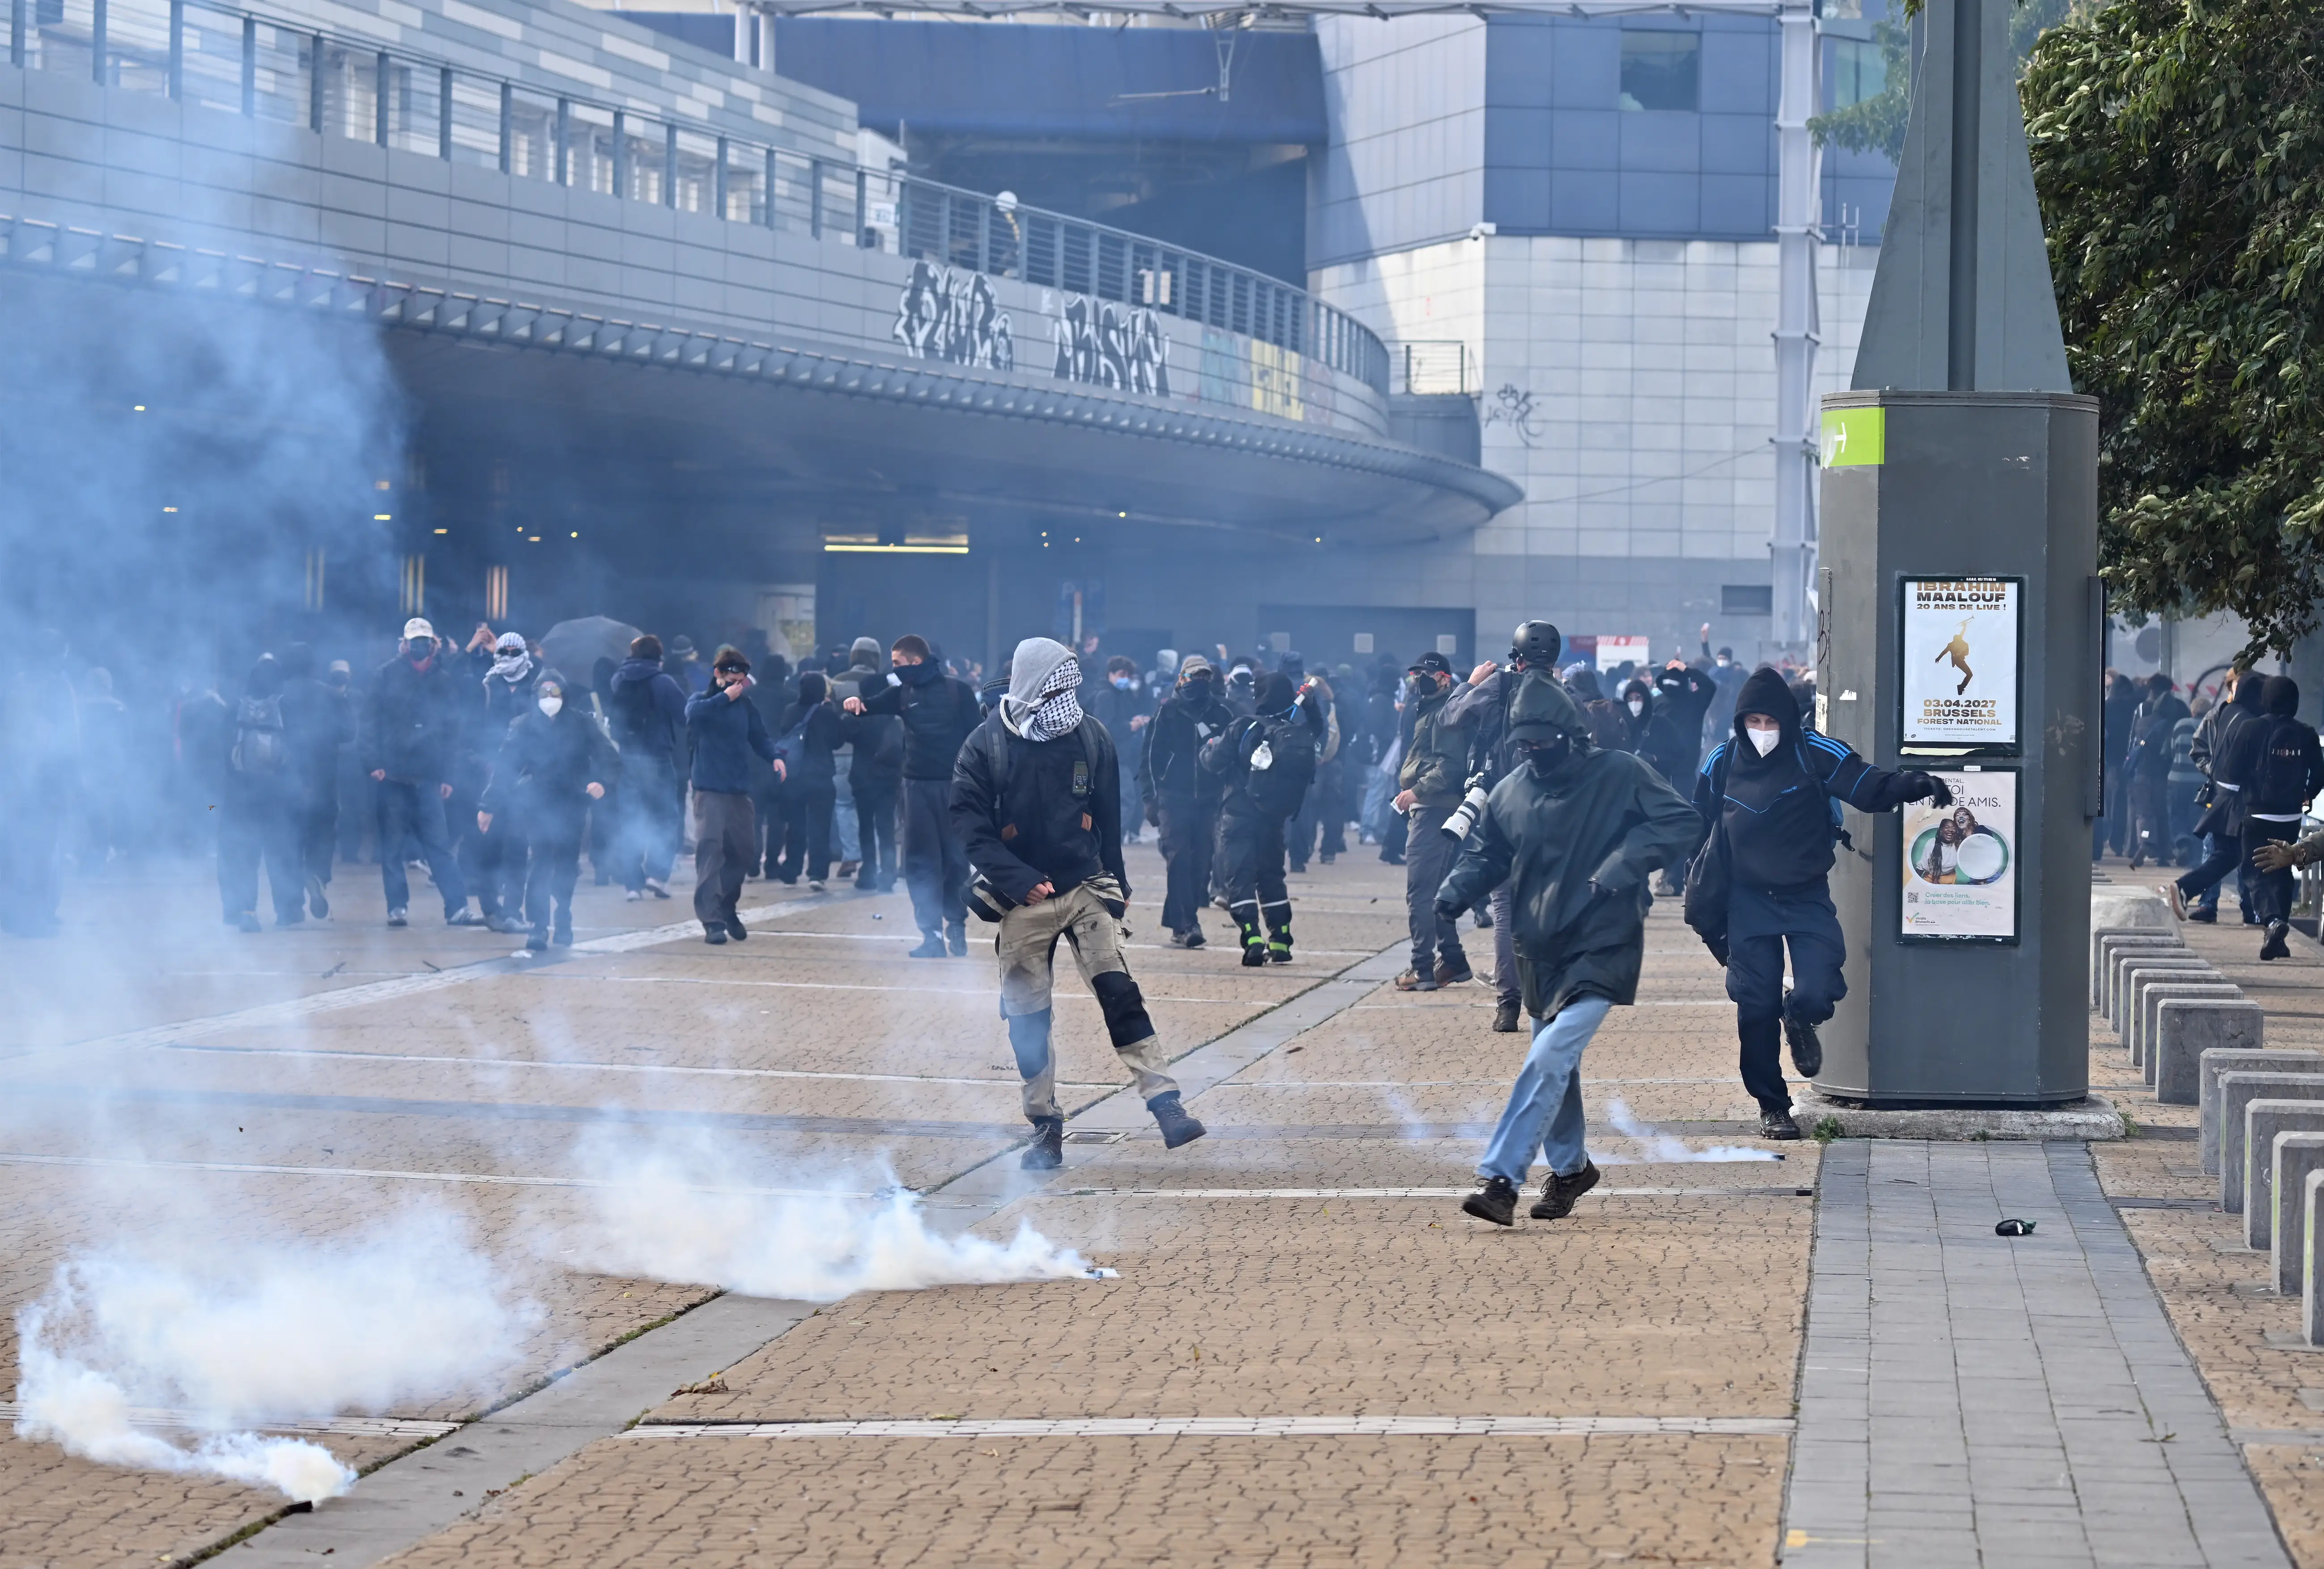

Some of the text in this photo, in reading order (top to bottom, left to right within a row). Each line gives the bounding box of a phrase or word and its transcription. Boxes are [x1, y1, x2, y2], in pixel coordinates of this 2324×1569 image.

[1917, 582, 2006, 592] IBRAHIM
[1917, 592, 2006, 602] MAALOUF
[1923, 699, 1996, 708] 03.04.2027
[1923, 709, 1996, 718] BRUSSELS
[1929, 796, 1965, 806] MDE
[1968, 797, 2001, 807] AMIS.
